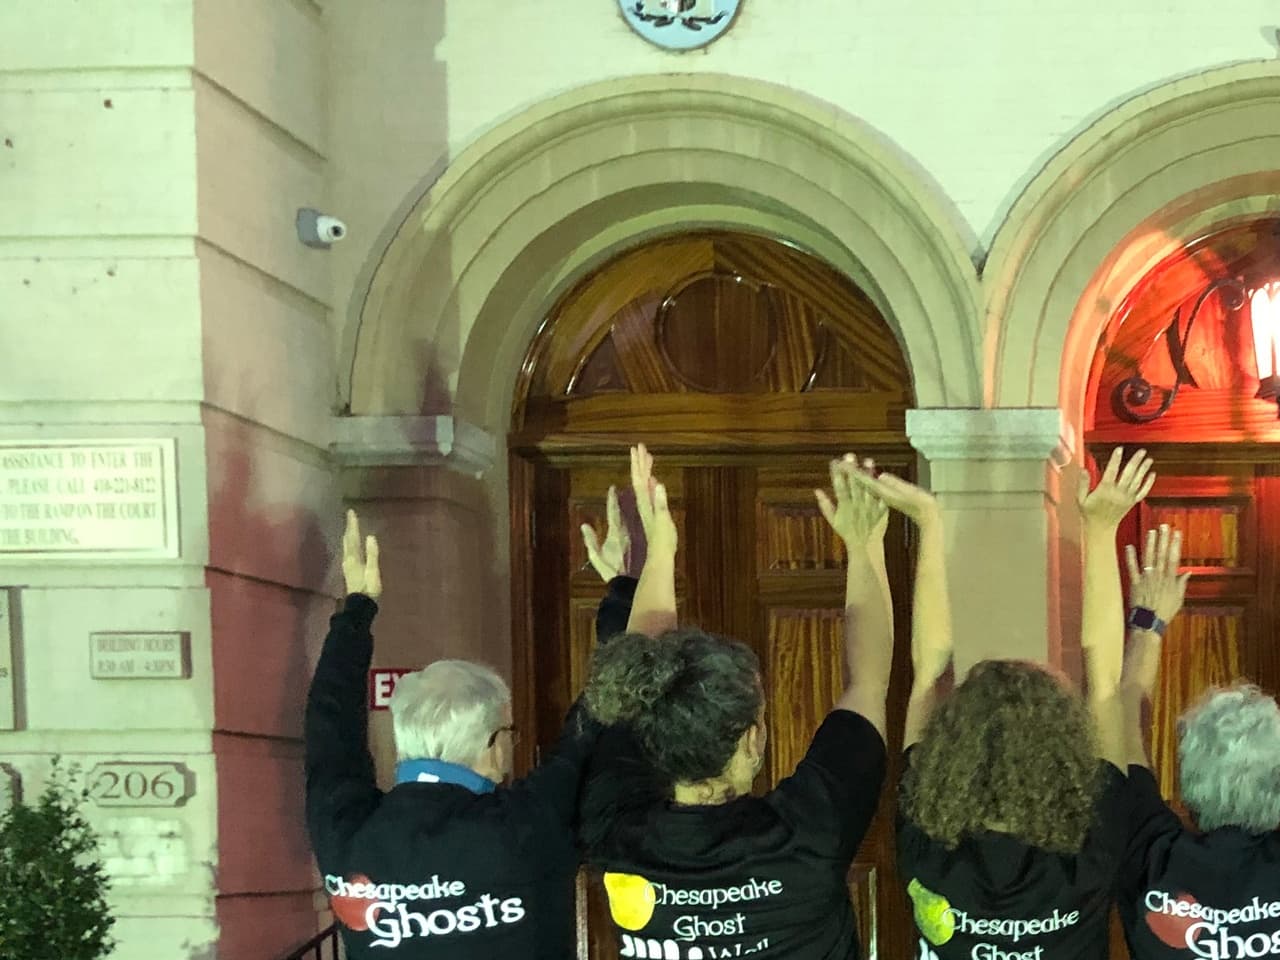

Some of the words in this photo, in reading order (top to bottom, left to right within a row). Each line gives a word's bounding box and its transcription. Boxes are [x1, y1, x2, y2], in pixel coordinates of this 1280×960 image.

[100, 771, 175, 799] 206
[325, 874, 466, 902] Chesapeake
[645, 878, 783, 909] Chesapeake
[365, 894, 526, 948] Ghosts
[673, 913, 747, 941] Ghost
[942, 908, 1080, 942] Chesapeake
